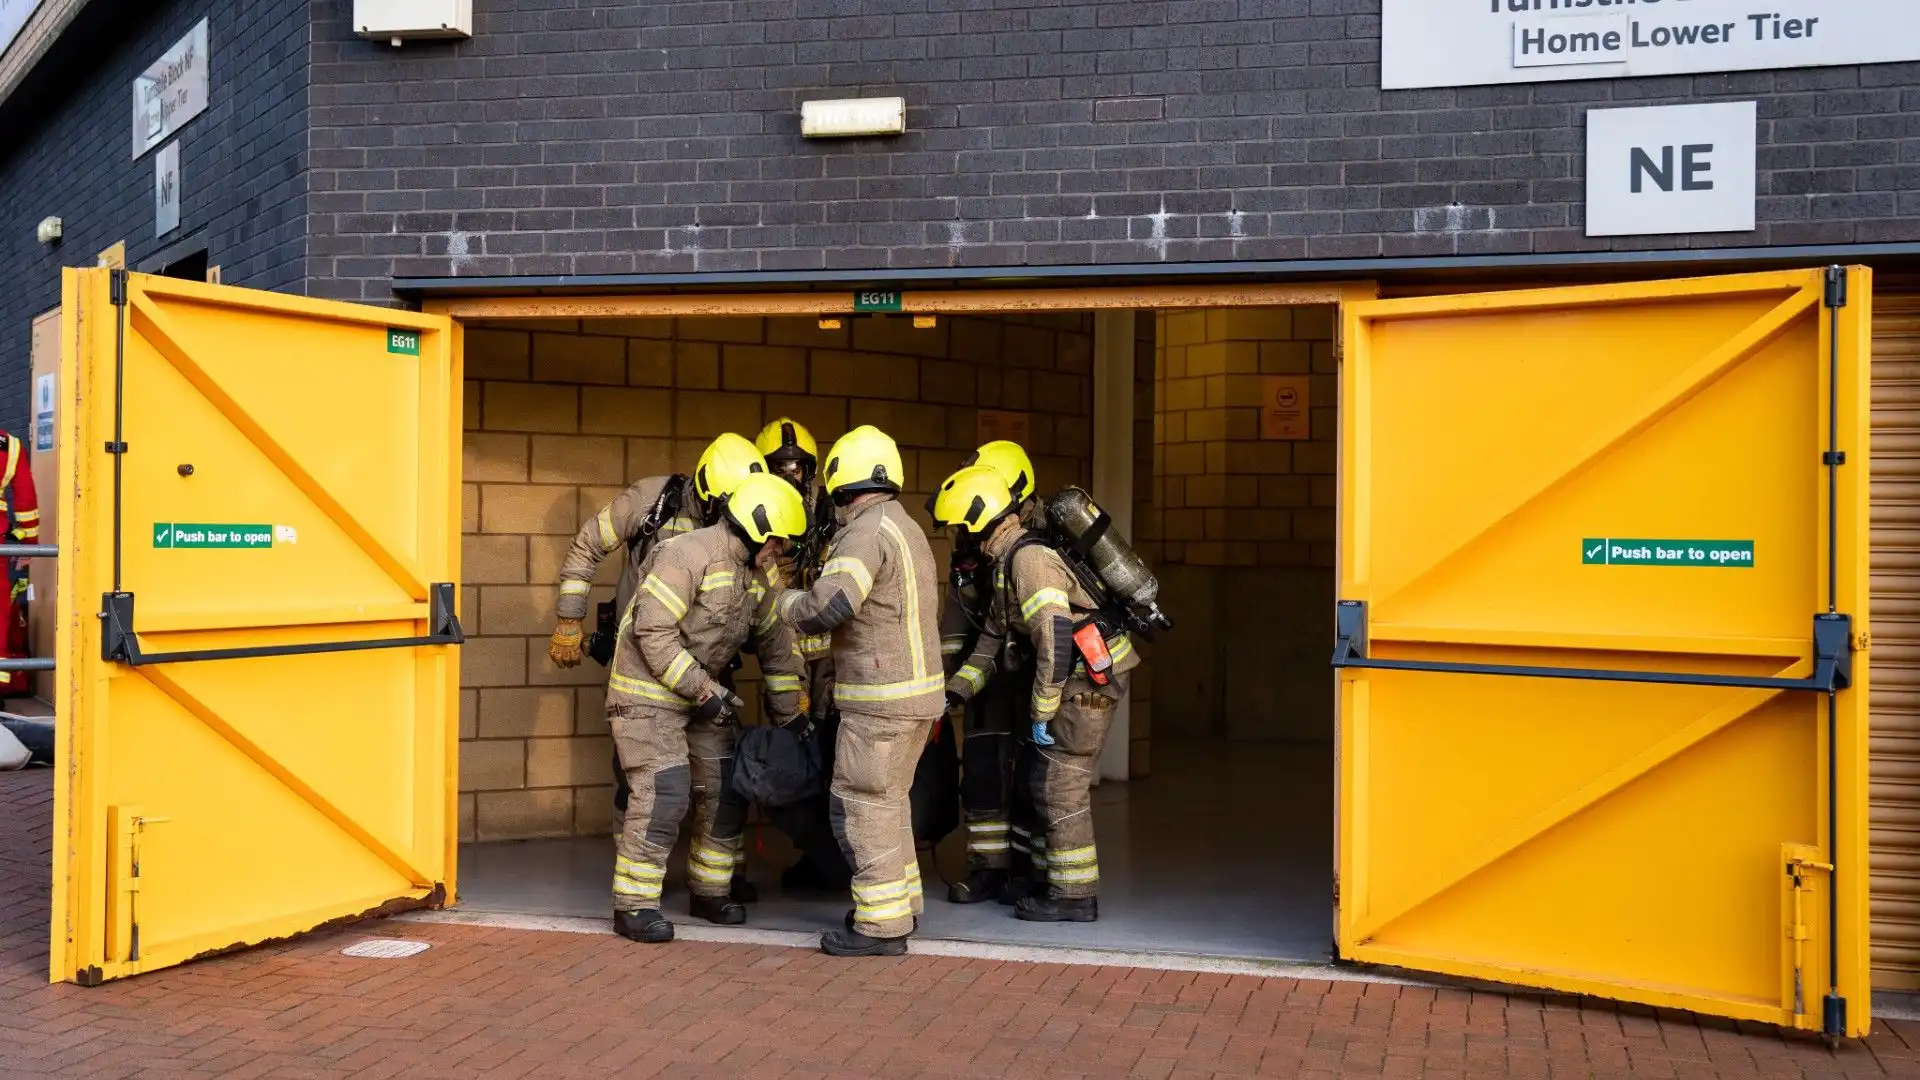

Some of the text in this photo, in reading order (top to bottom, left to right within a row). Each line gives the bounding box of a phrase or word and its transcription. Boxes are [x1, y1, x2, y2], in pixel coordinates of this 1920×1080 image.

[1522, 13, 1819, 54] Home Lower Tier
[1630, 143, 1714, 193] NE
[161, 170, 173, 207] NF
[861, 292, 895, 305] EG11
[392, 335, 415, 349] EG11
[175, 530, 271, 545] Push bar to open
[1611, 546, 1751, 563] Push bar to open
